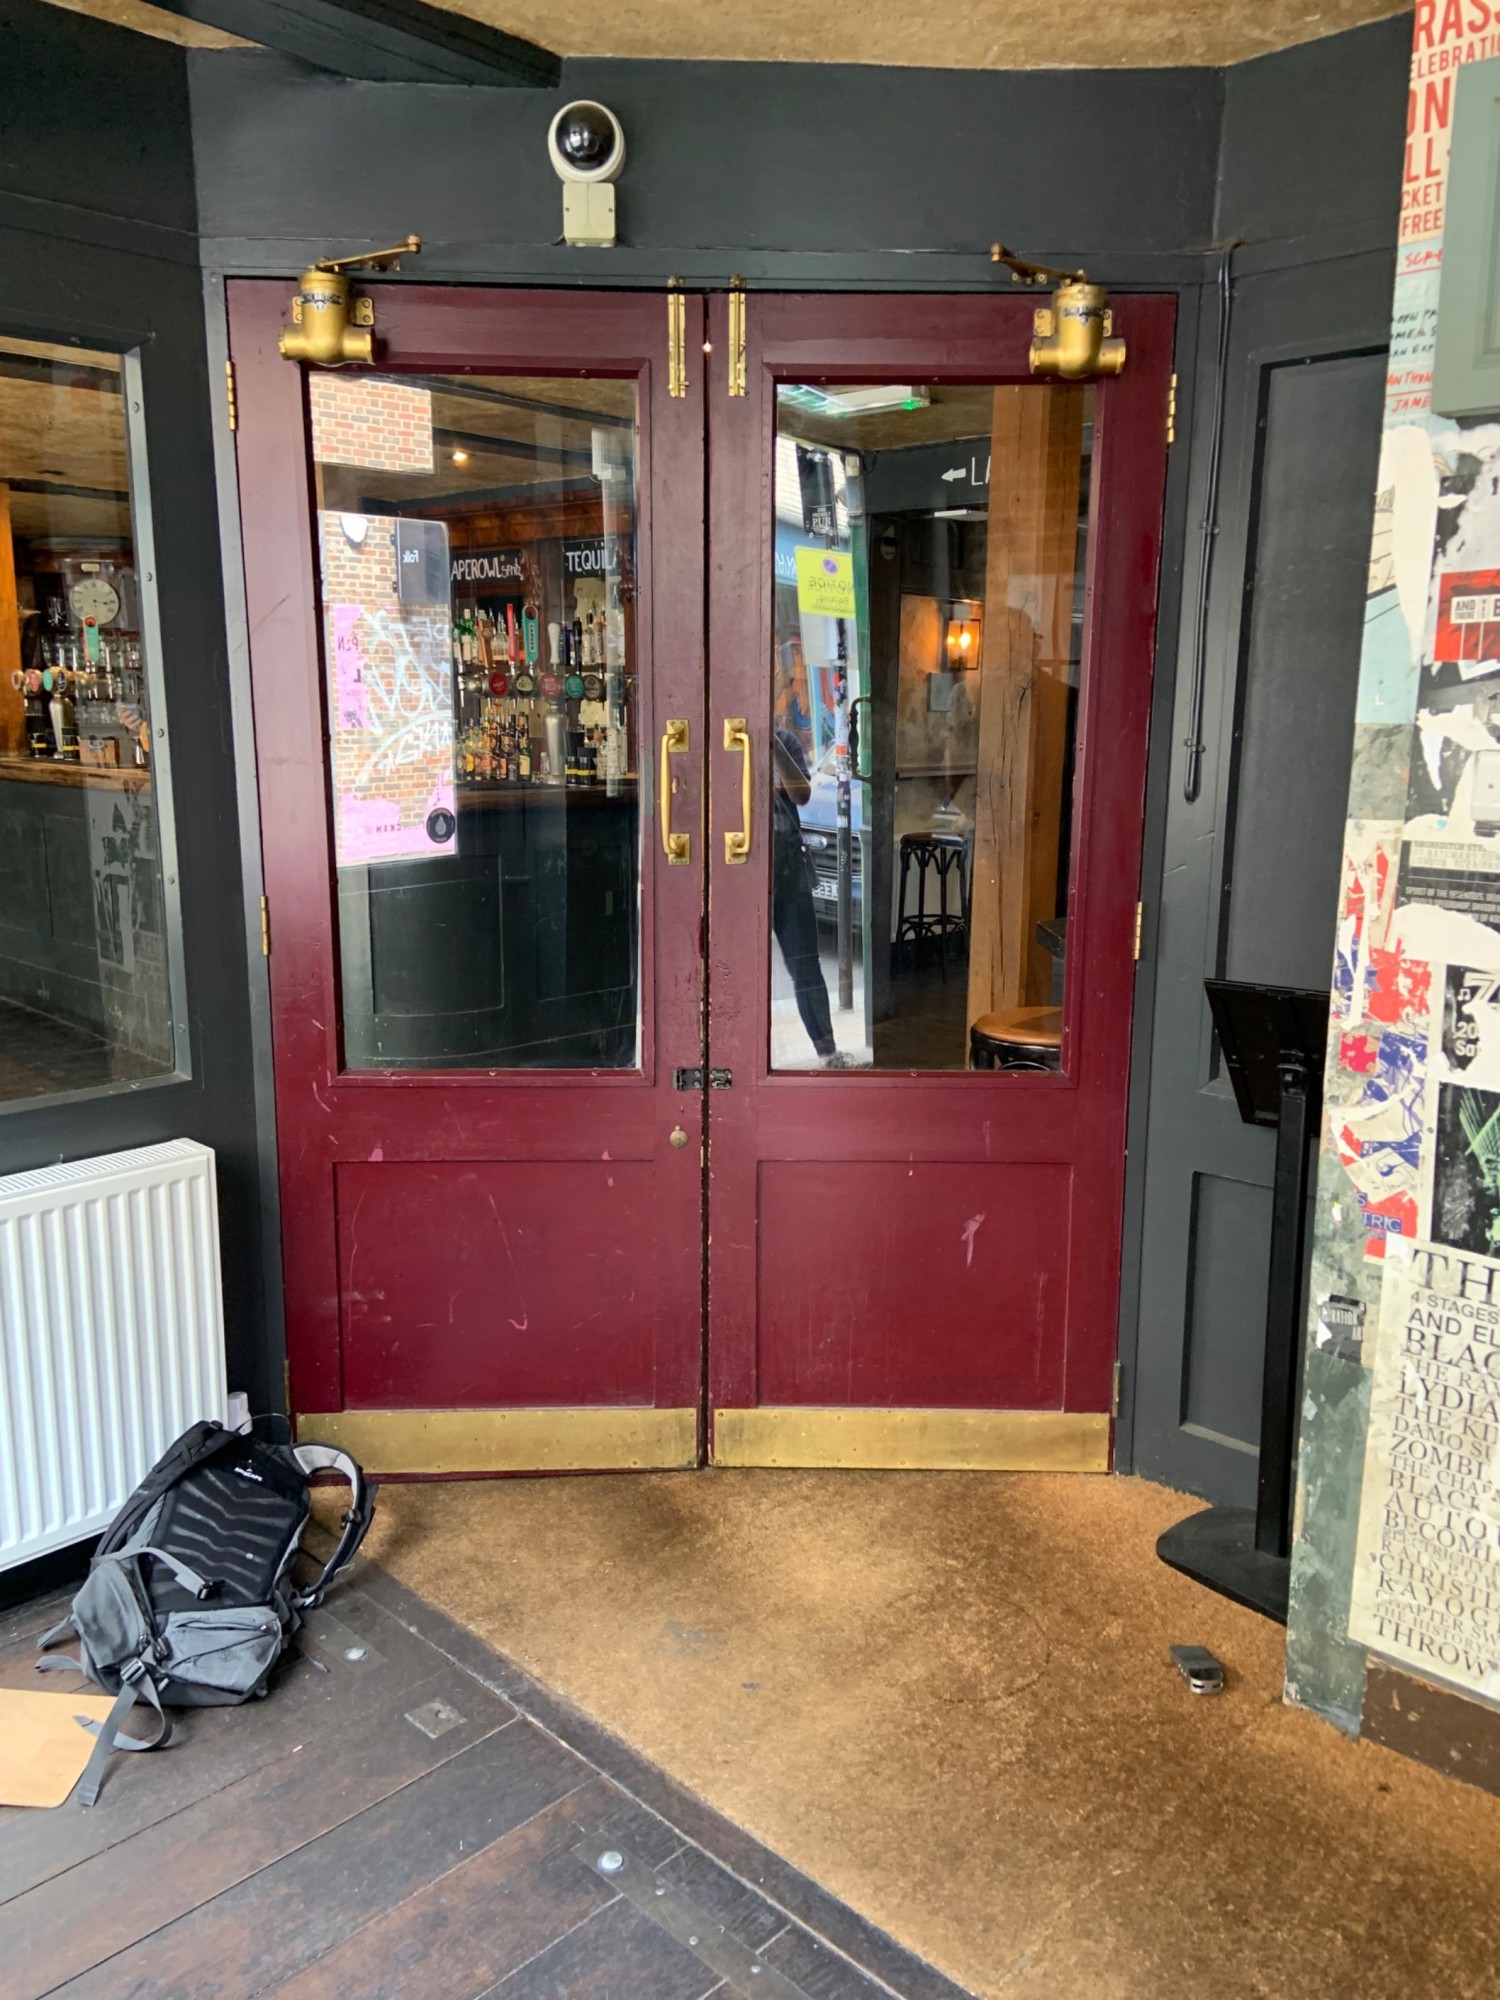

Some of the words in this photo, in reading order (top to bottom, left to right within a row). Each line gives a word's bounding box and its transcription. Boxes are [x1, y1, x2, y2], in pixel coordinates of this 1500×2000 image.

[1412, 0, 1500, 53] RAS
[1401, 208, 1443, 237] FREE
[812, 517, 831, 527] PUB
[1408, 1307, 1462, 1336] AND
[1427, 1294, 1500, 1325] STAGES
[1395, 1394, 1452, 1431] THE
[1398, 1369, 1500, 1424] LYDIA
[1394, 1415, 1463, 1451] DAMO
[1388, 1452, 1431, 1480] THE
[1391, 1433, 1493, 1485] ZOMBI
[1383, 1508, 1500, 1567] BECOMI
[1372, 1613, 1488, 1678] THROW
